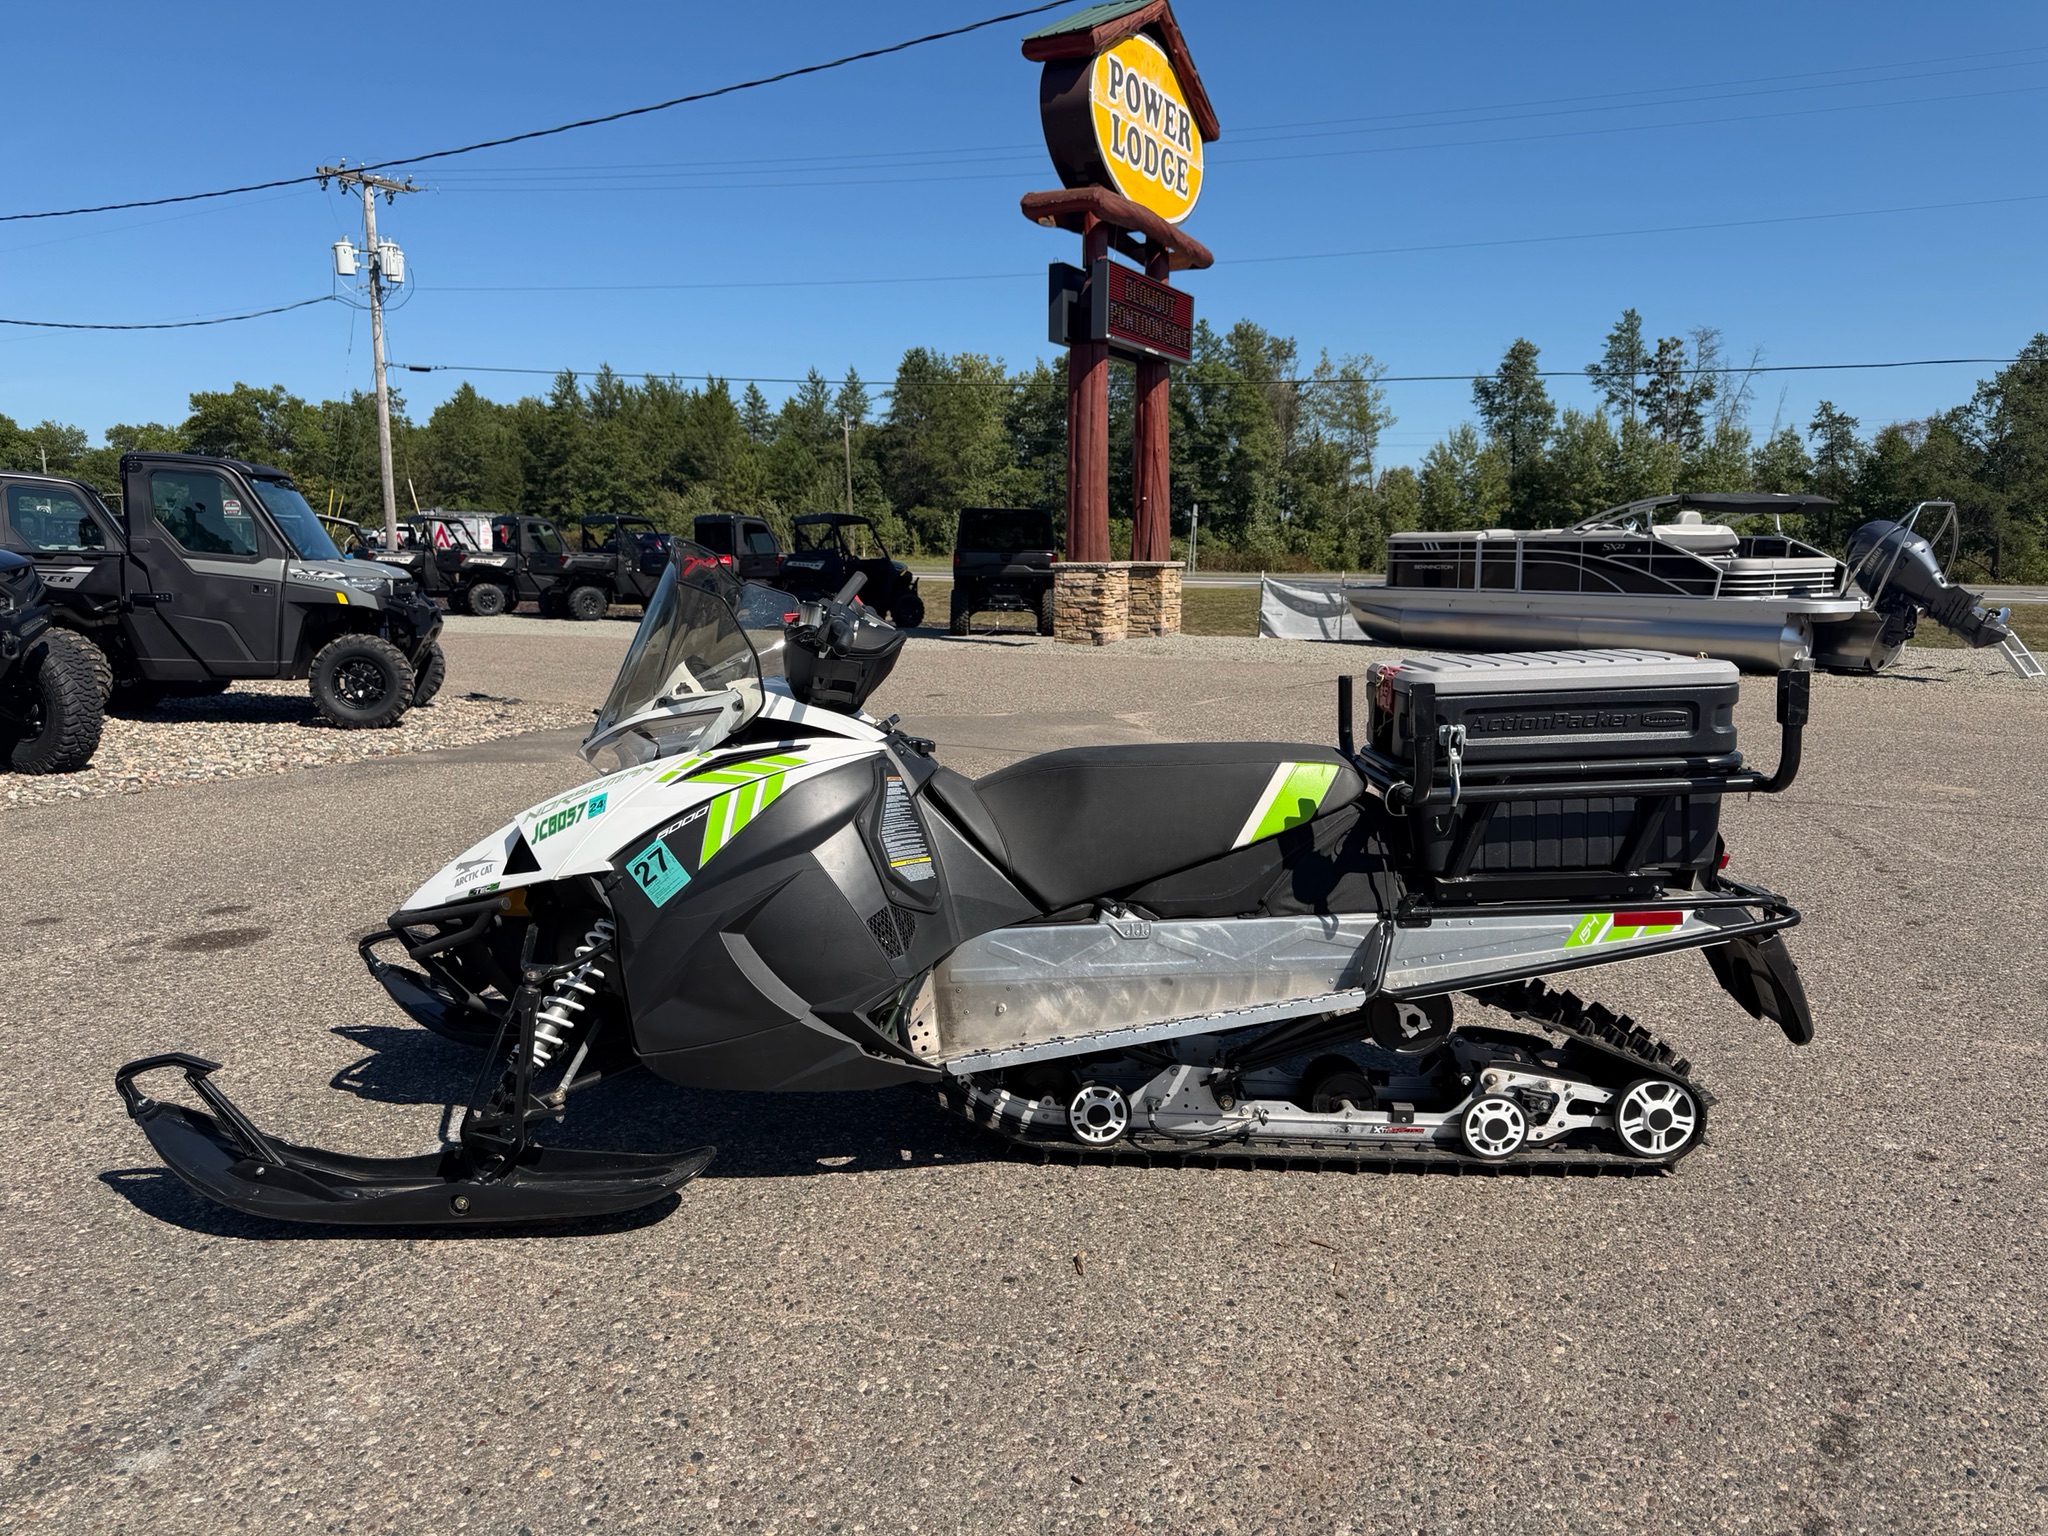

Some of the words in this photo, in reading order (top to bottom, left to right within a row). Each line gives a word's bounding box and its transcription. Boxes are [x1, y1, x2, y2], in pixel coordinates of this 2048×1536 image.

[1109, 57, 1192, 153] POWER
[1112, 113, 1189, 196] LODGE
[1124, 277, 1176, 319] BLOWOUT
[1602, 543, 1626, 551] SX22
[1866, 547, 1884, 570] YAMAHA
[1467, 710, 1638, 734] ActionPacker
[522, 762, 660, 825] NORSEMAN
[588, 799, 604, 814] 24
[453, 869, 480, 889] ARCTIC
[480, 863, 494, 877] CAT
[633, 846, 669, 889] 27
[1579, 915, 1600, 945] 154
